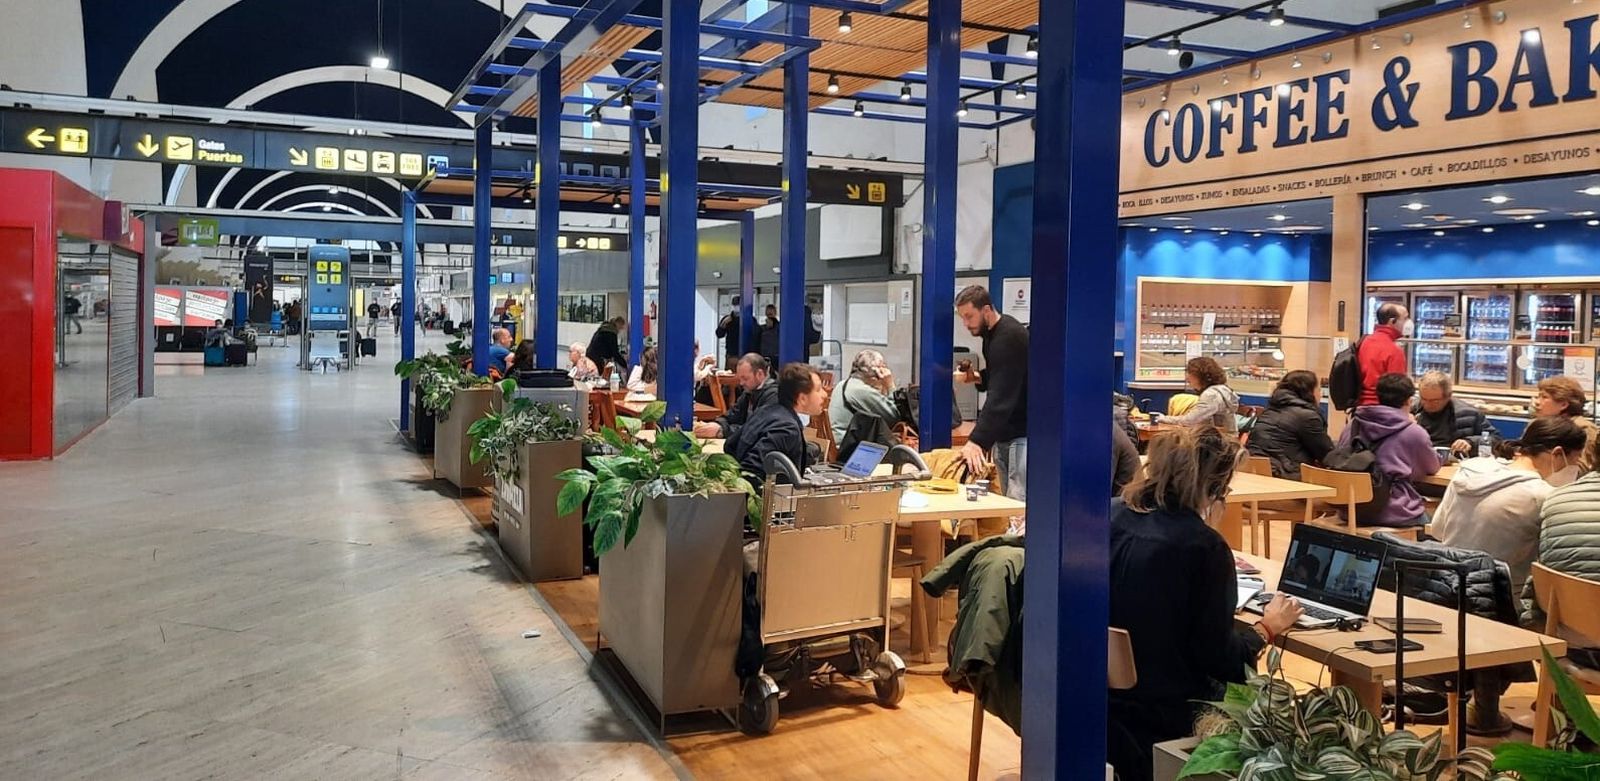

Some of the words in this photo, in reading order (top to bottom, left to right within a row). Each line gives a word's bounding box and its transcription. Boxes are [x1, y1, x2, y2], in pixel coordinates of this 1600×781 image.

[1144, 69, 1350, 168] COFFEE
[1371, 56, 1420, 132] &
[1445, 14, 1600, 121] BAK
[198, 139, 225, 151] Gates
[198, 150, 244, 163] Puertas
[1160, 194, 1195, 204] DESAYUNOS
[1200, 190, 1223, 200] ZUMOS
[1232, 185, 1271, 197] ENSALADAS
[1278, 180, 1306, 192] SNACKS
[1314, 174, 1352, 188] BOLLERÍA
[1361, 169, 1397, 183] BRUNCH
[1410, 163, 1434, 176] CAFÉ
[1447, 157, 1508, 173] BOCADILLOS
[1523, 147, 1590, 165] DESAYUNOS
